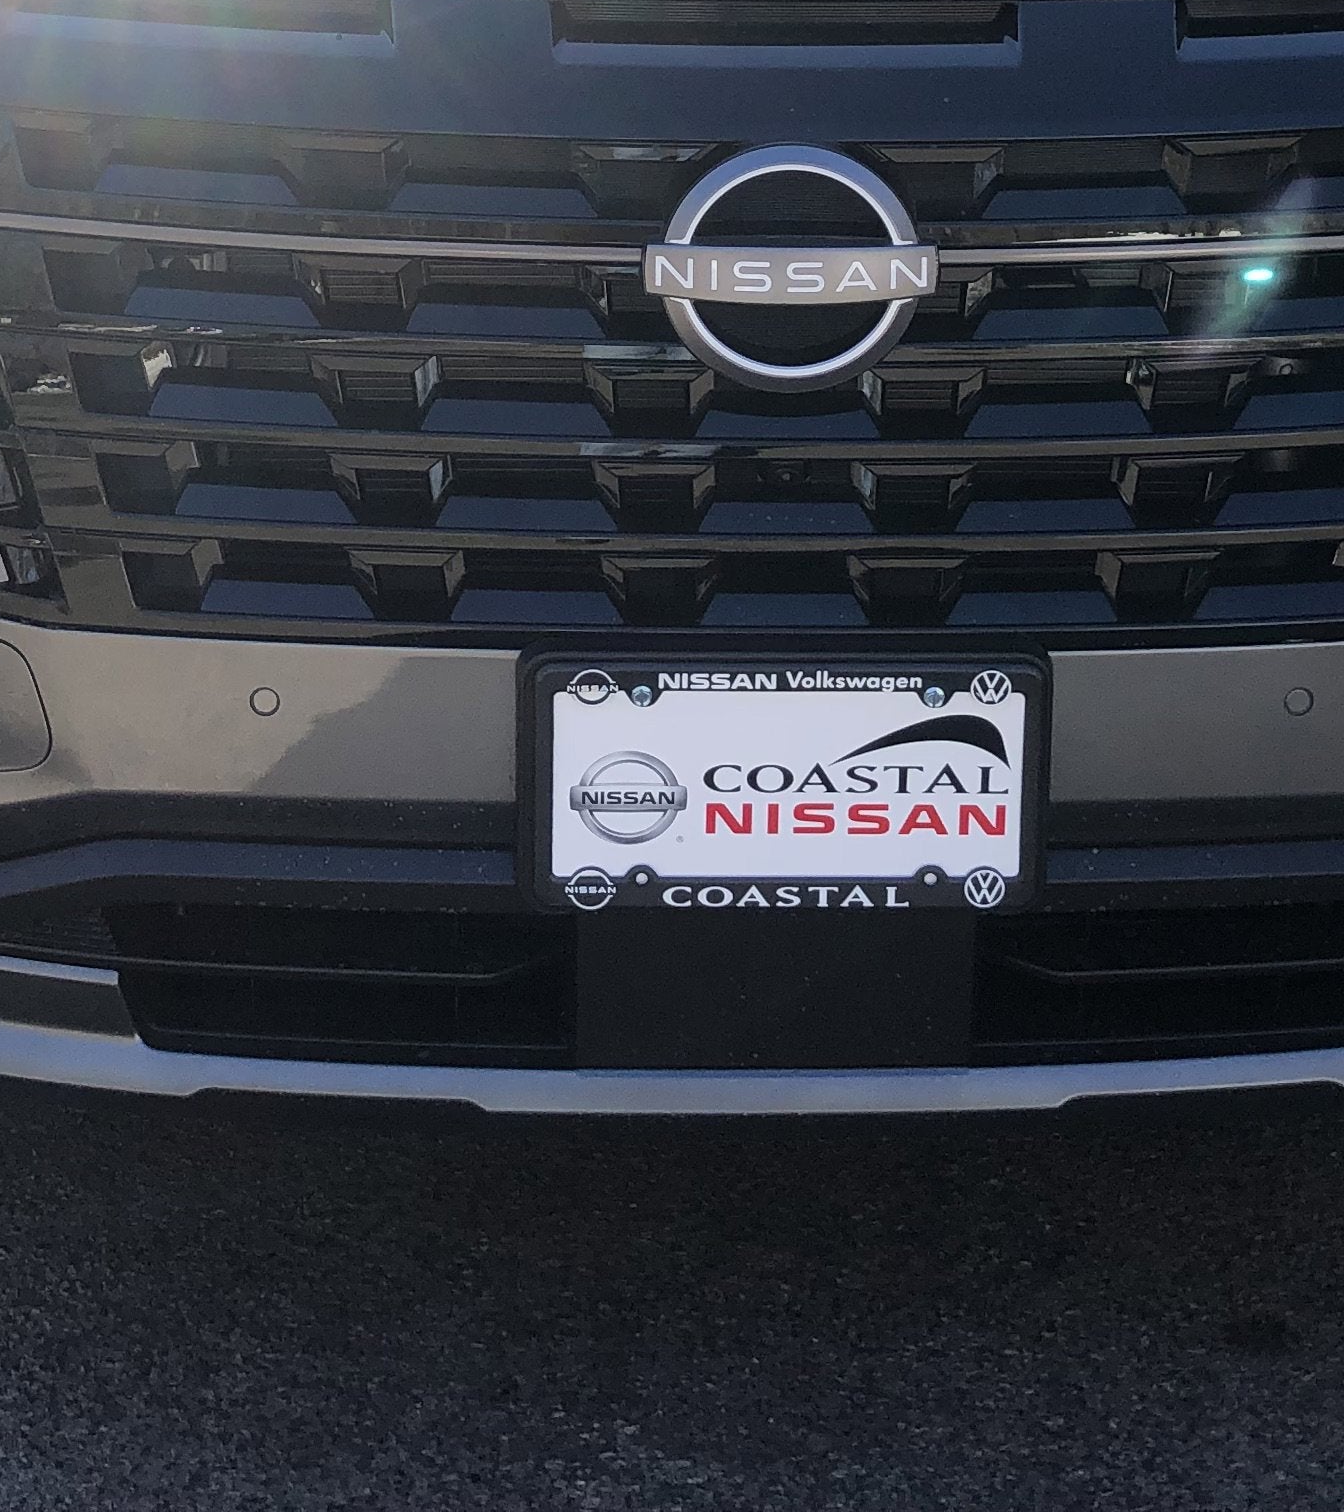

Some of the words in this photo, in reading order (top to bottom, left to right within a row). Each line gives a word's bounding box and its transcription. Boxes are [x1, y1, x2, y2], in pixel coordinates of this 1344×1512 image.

[654, 255, 929, 294] NISSAN
[566, 684, 619, 693] NISSAN
[658, 672, 778, 690] NISSAN
[785, 670, 923, 693] Volkswagen
[702, 762, 1010, 796] COASTAL
[581, 791, 676, 806] NISSAN
[704, 803, 1007, 836] NISSAN
[565, 885, 617, 895] NISSAN
[662, 884, 910, 908] COASTAL
